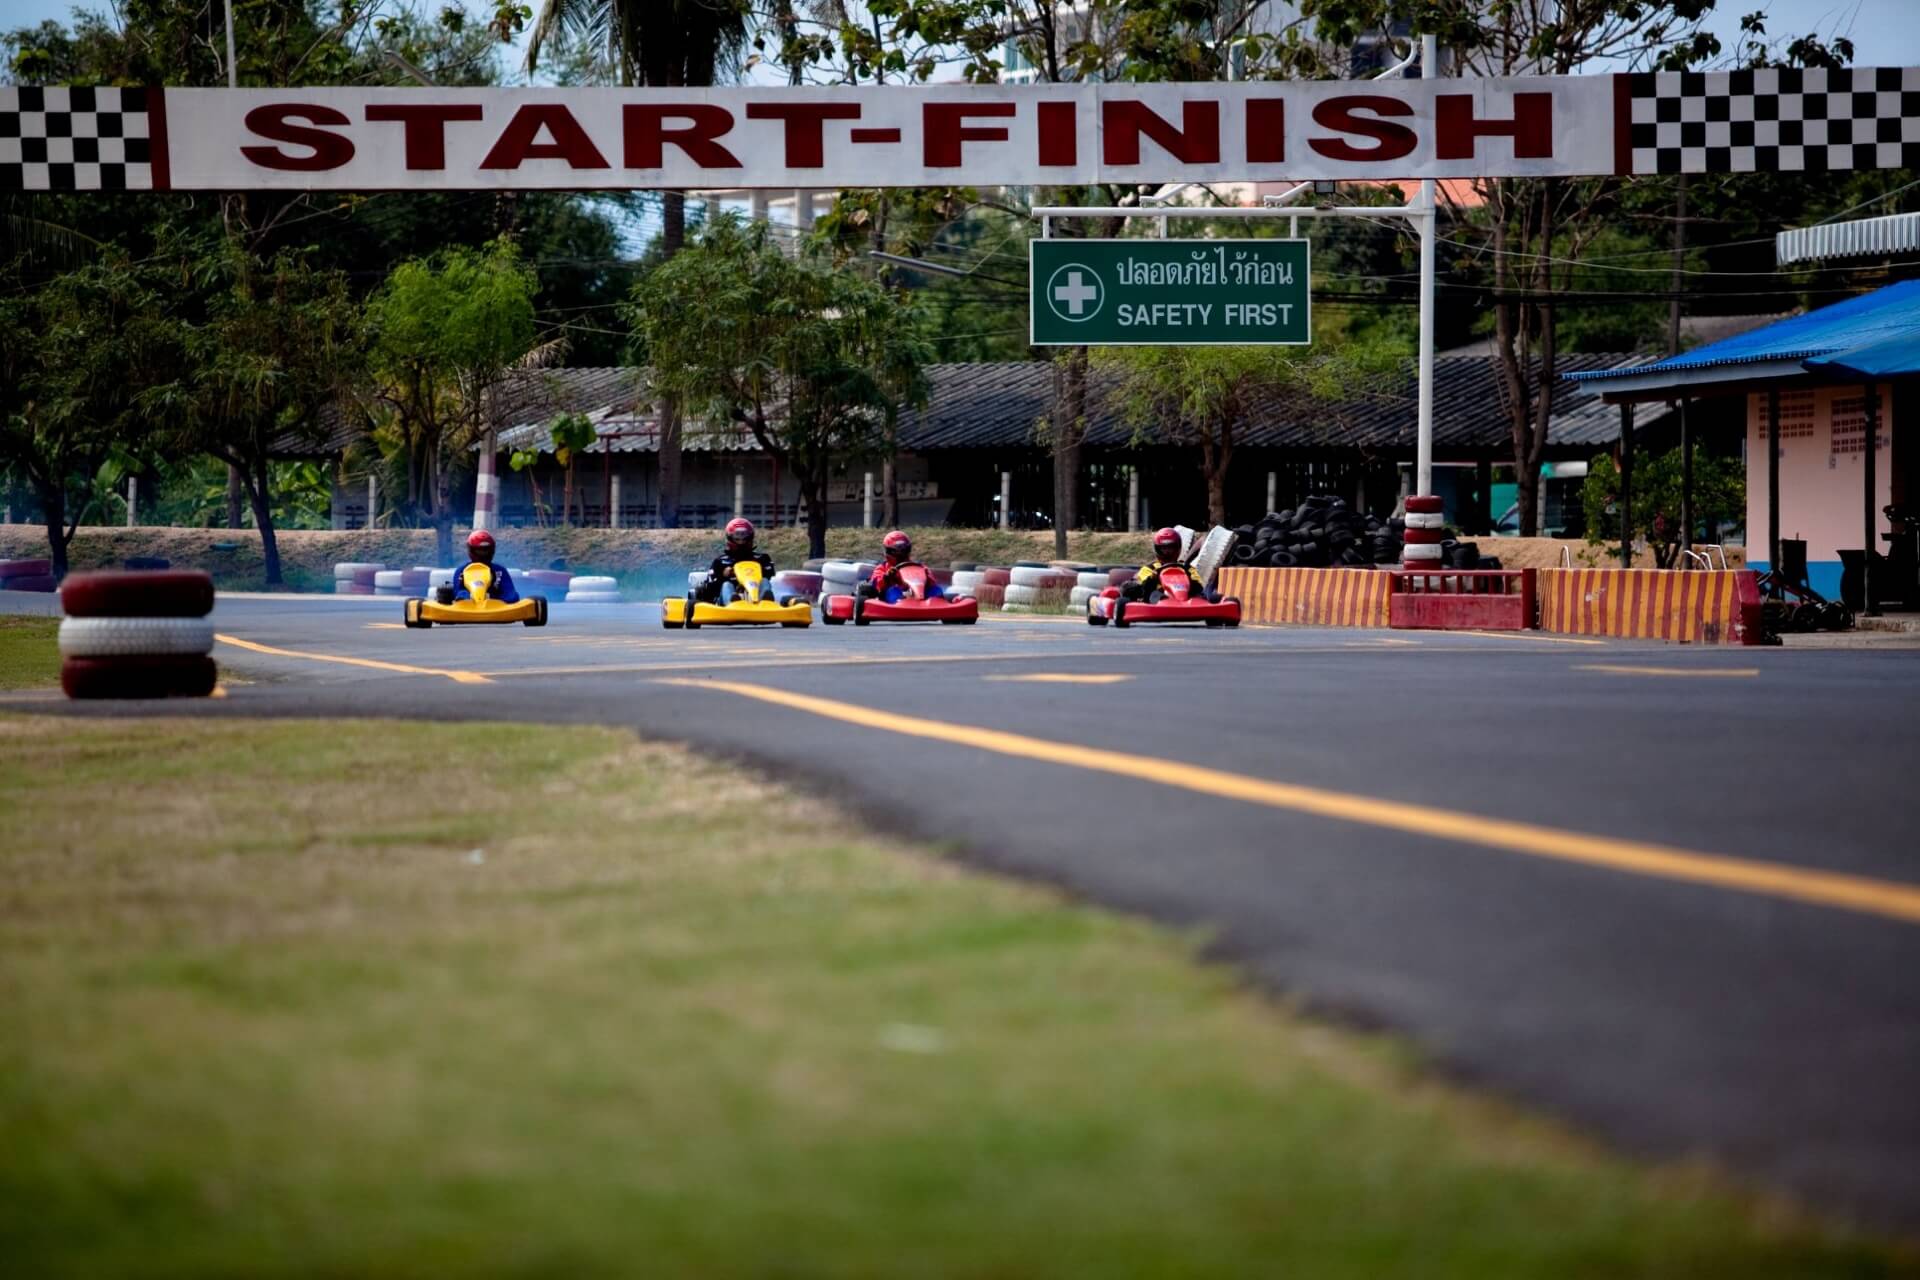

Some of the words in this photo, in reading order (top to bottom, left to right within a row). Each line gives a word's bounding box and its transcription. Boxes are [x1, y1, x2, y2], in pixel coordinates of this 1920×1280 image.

[239, 92, 1553, 171] START-FINISH
[1116, 246, 1294, 285] ปลอดภัยไว้ก่อน
[1117, 303, 1213, 326] SAFETY
[1225, 303, 1293, 326] FIRST
